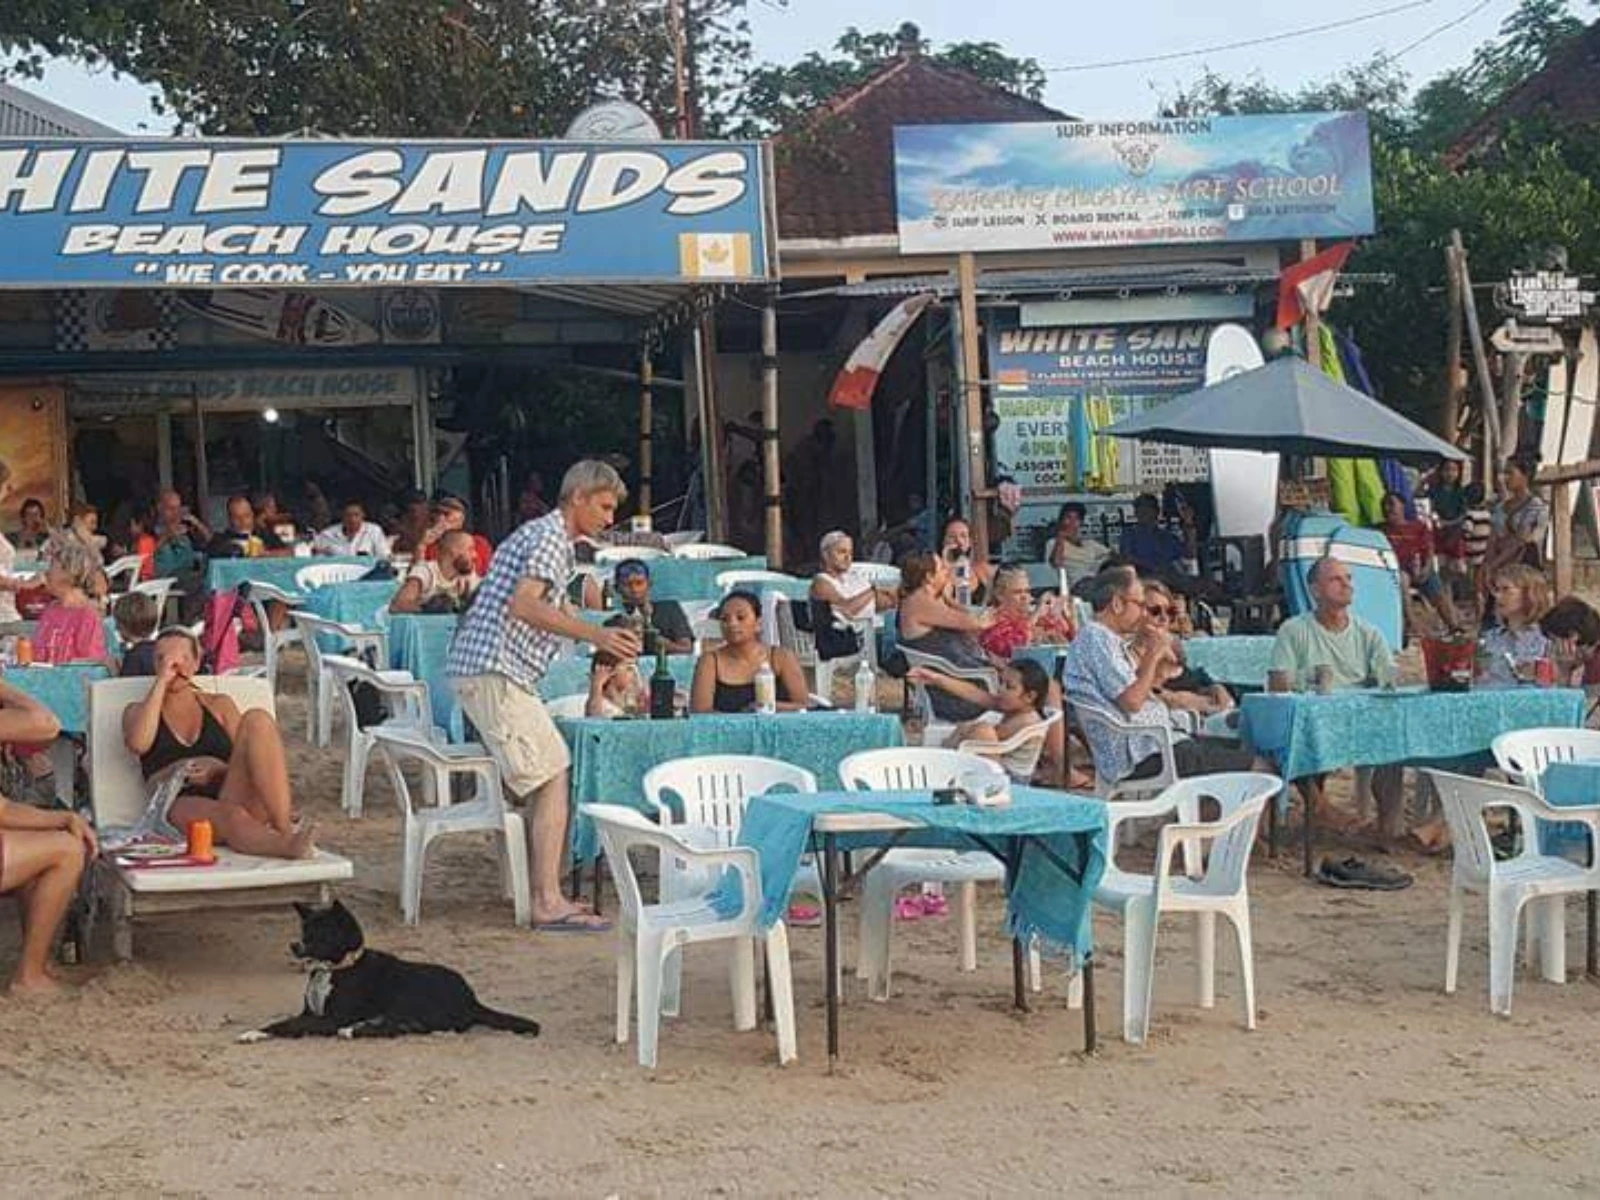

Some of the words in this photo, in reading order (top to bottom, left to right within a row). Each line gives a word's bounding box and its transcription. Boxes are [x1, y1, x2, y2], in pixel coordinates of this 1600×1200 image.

[1056, 124, 1094, 138] SURF
[1098, 120, 1212, 136] INFORMATION
[313, 149, 748, 216] SANDS
[1233, 173, 1342, 200] SCHOOL
[1052, 213, 1094, 225] BOARD
[1097, 211, 1140, 224] RENTAL
[61, 224, 307, 255] BEACH
[319, 223, 566, 255] HOUSE
[164, 264, 214, 283] WE
[219, 264, 310, 283] COOK
[345, 264, 406, 281] YOU
[412, 263, 473, 281] EAT
[1000, 328, 1117, 354] WHITE
[1058, 354, 1125, 368] BEACH
[1132, 352, 1199, 366] HOUSE
